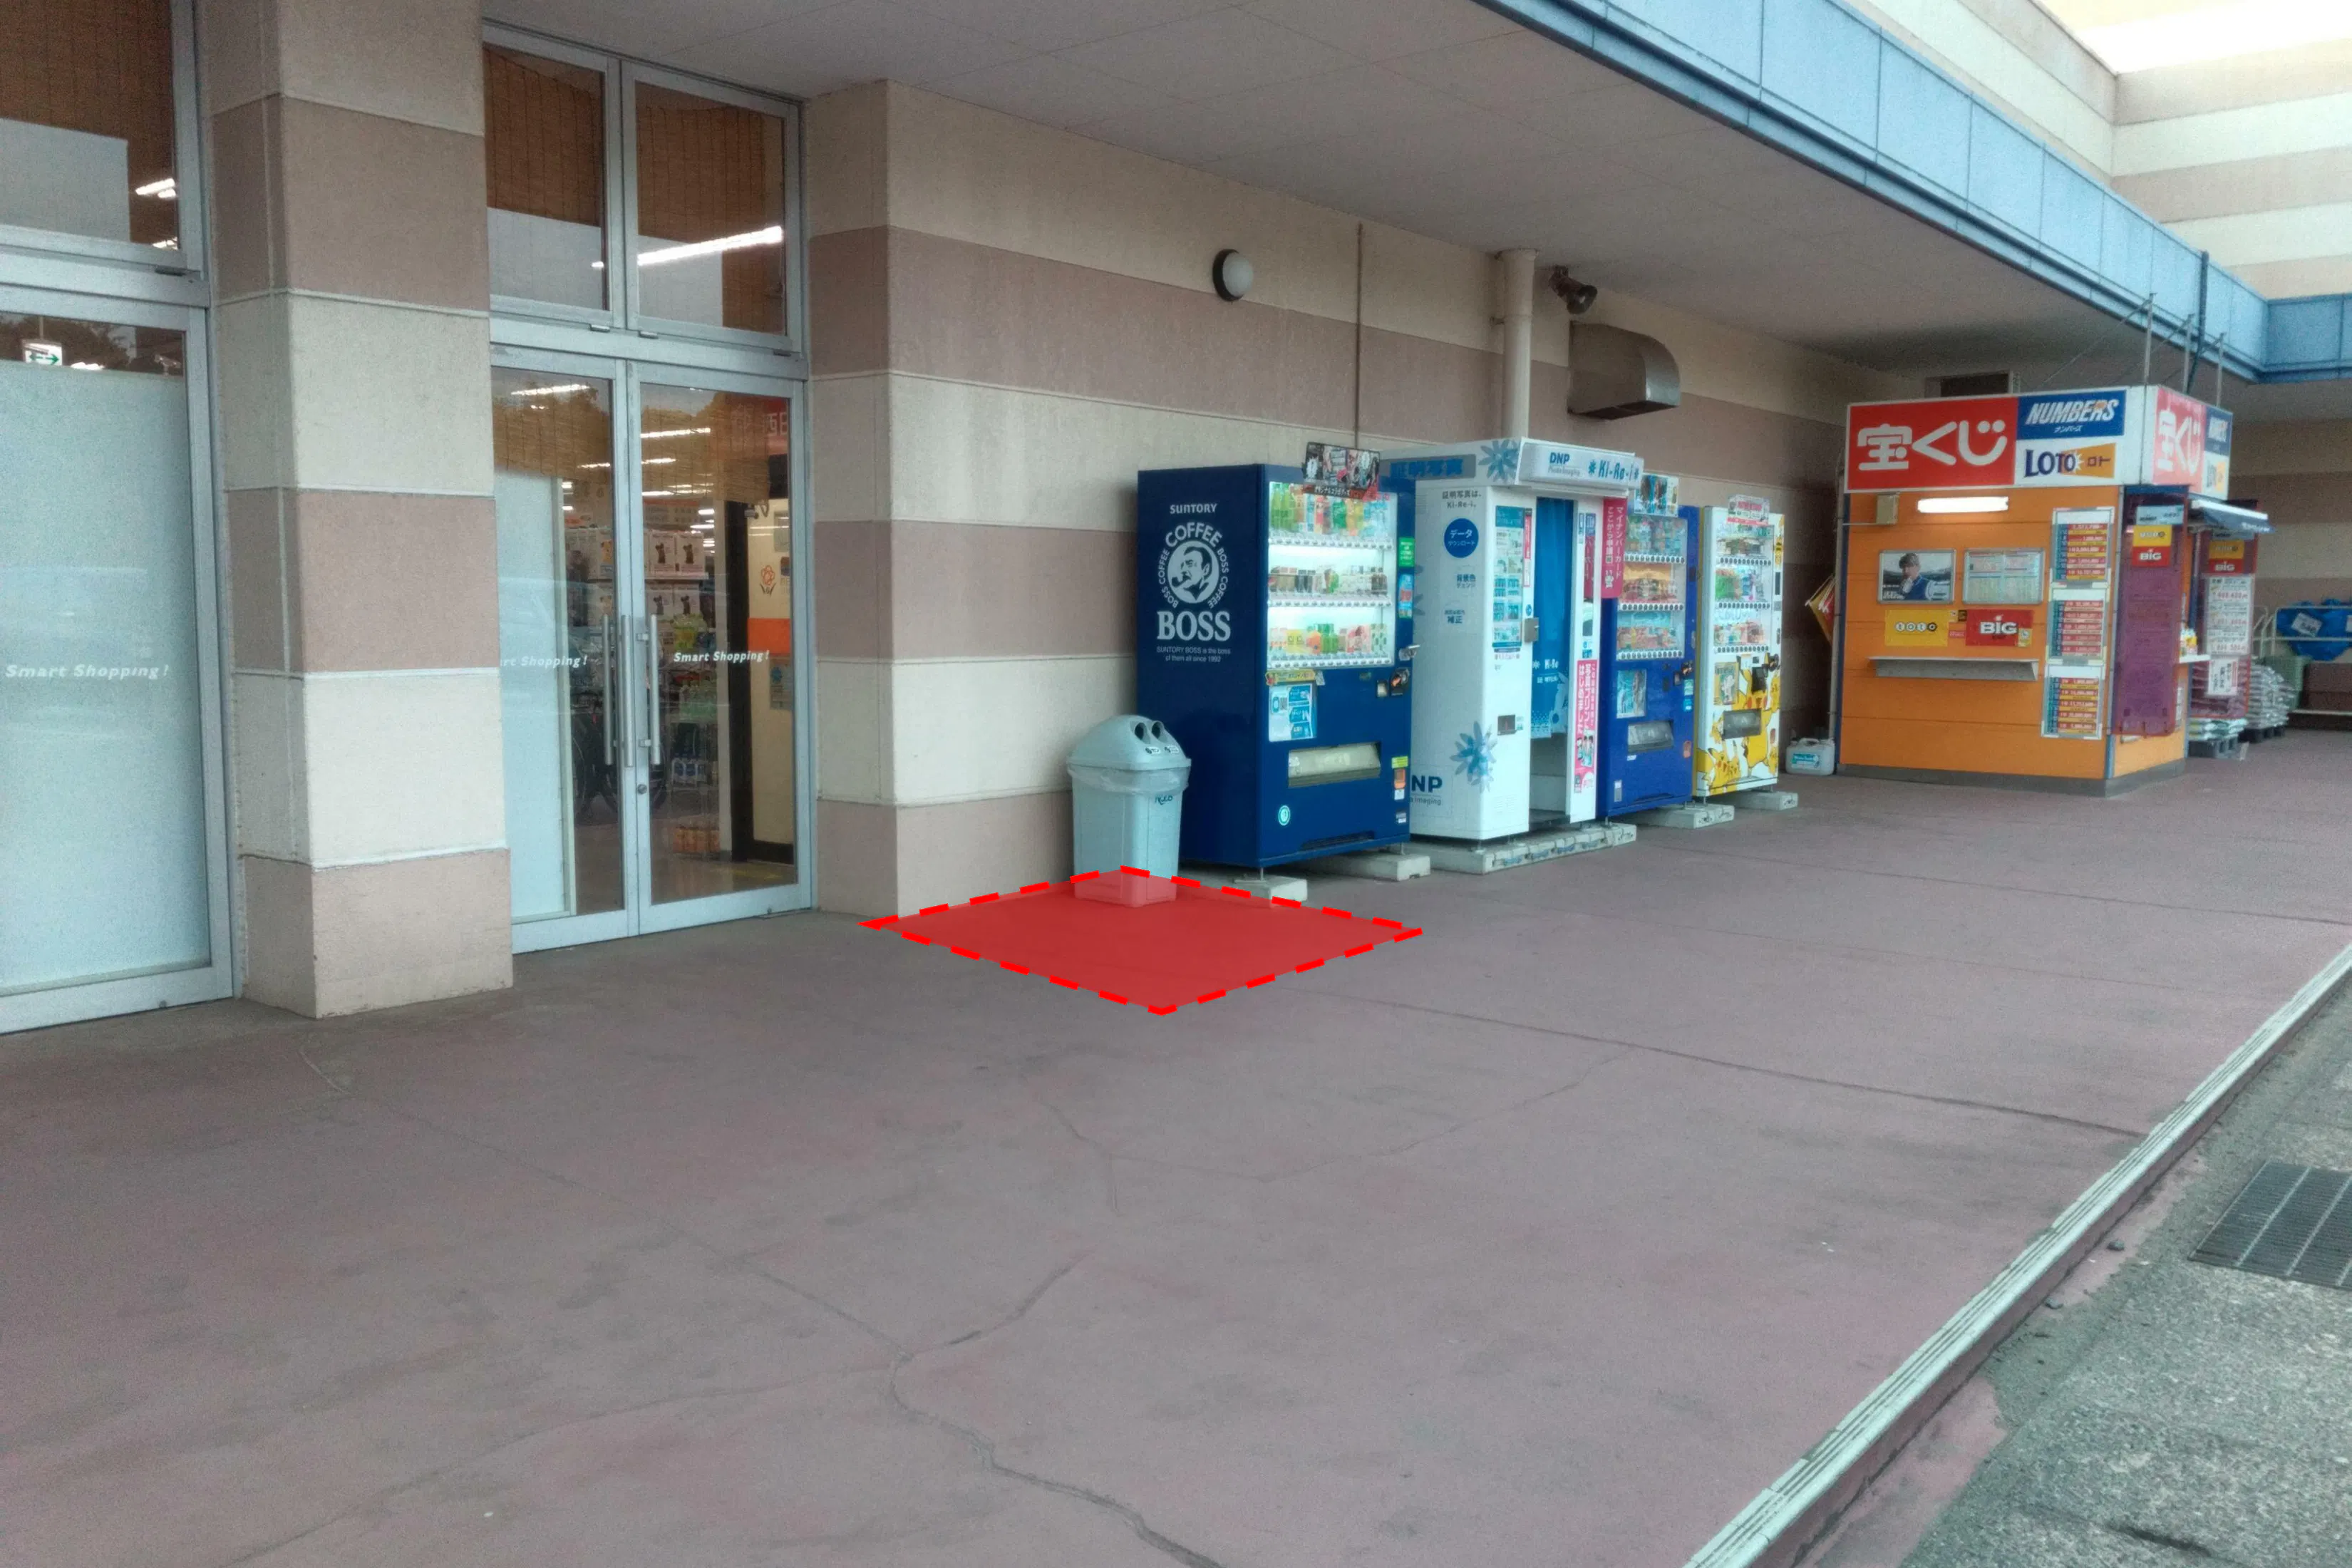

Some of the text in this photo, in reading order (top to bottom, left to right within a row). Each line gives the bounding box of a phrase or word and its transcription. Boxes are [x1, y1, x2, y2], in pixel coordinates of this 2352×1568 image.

[2026, 399, 2119, 424] NUMBERS
[1857, 420, 2008, 470] 宝くじ
[1550, 452, 1570, 464] DNP
[2024, 449, 2076, 477] LOTO
[2088, 456, 2110, 467] ロト
[1170, 503, 1217, 514] SUNTORY
[1165, 522, 1222, 547] COFFEE
[1450, 529, 1472, 539] データ
[1157, 611, 1231, 641] BOSS
[674, 650, 769, 662] Smart Shopping!
[6, 664, 68, 677] Smart
[1411, 775, 1443, 793] NP
